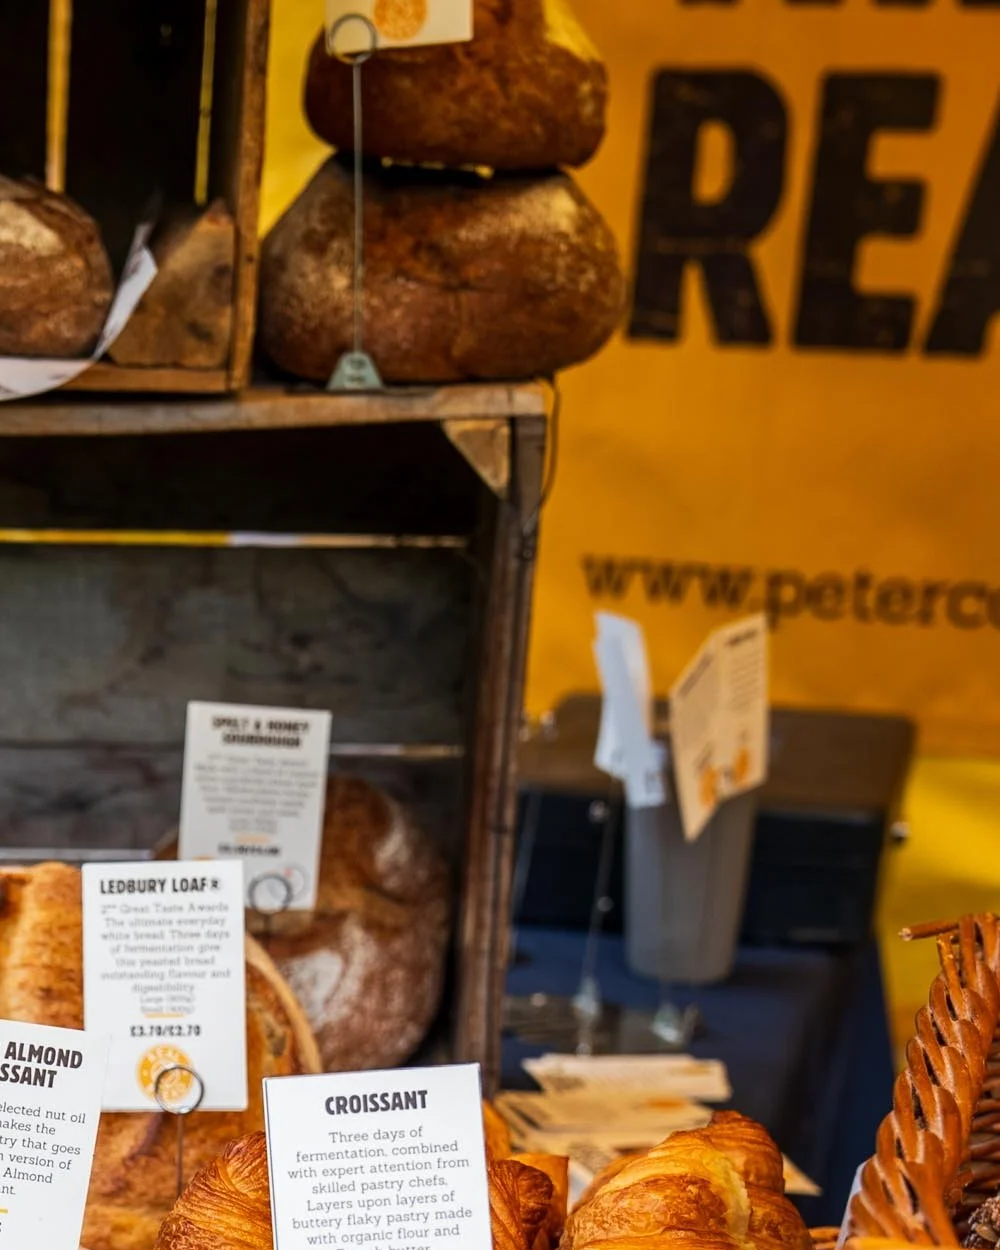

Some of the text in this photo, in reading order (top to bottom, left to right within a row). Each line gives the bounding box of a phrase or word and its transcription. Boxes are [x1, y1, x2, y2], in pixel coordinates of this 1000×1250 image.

[100, 877, 207, 894] LEDBURY LOAF
[4, 1042, 82, 1069] ALMOND
[325, 1090, 427, 1115] CROISSANT
[46, 1111, 65, 1121] nut
[71, 1113, 85, 1123] oil
[36, 1123, 55, 1135] the
[328, 1126, 422, 1143] Three days of
[22, 1137, 47, 1150] that
[52, 1144, 80, 1155] goes
[392, 1140, 458, 1155] combined
[9, 1154, 54, 1168] version
[59, 1160, 72, 1170] of
[288, 1158, 469, 1179] with expert attention from
[3, 1167, 52, 1183] Almond
[312, 1175, 447, 1194] skilled pastry chefs.
[307, 1190, 455, 1213] Layers upon layers of
[292, 1207, 472, 1229] buttery flaky pastry made
[307, 1224, 460, 1245] with organic flour and
